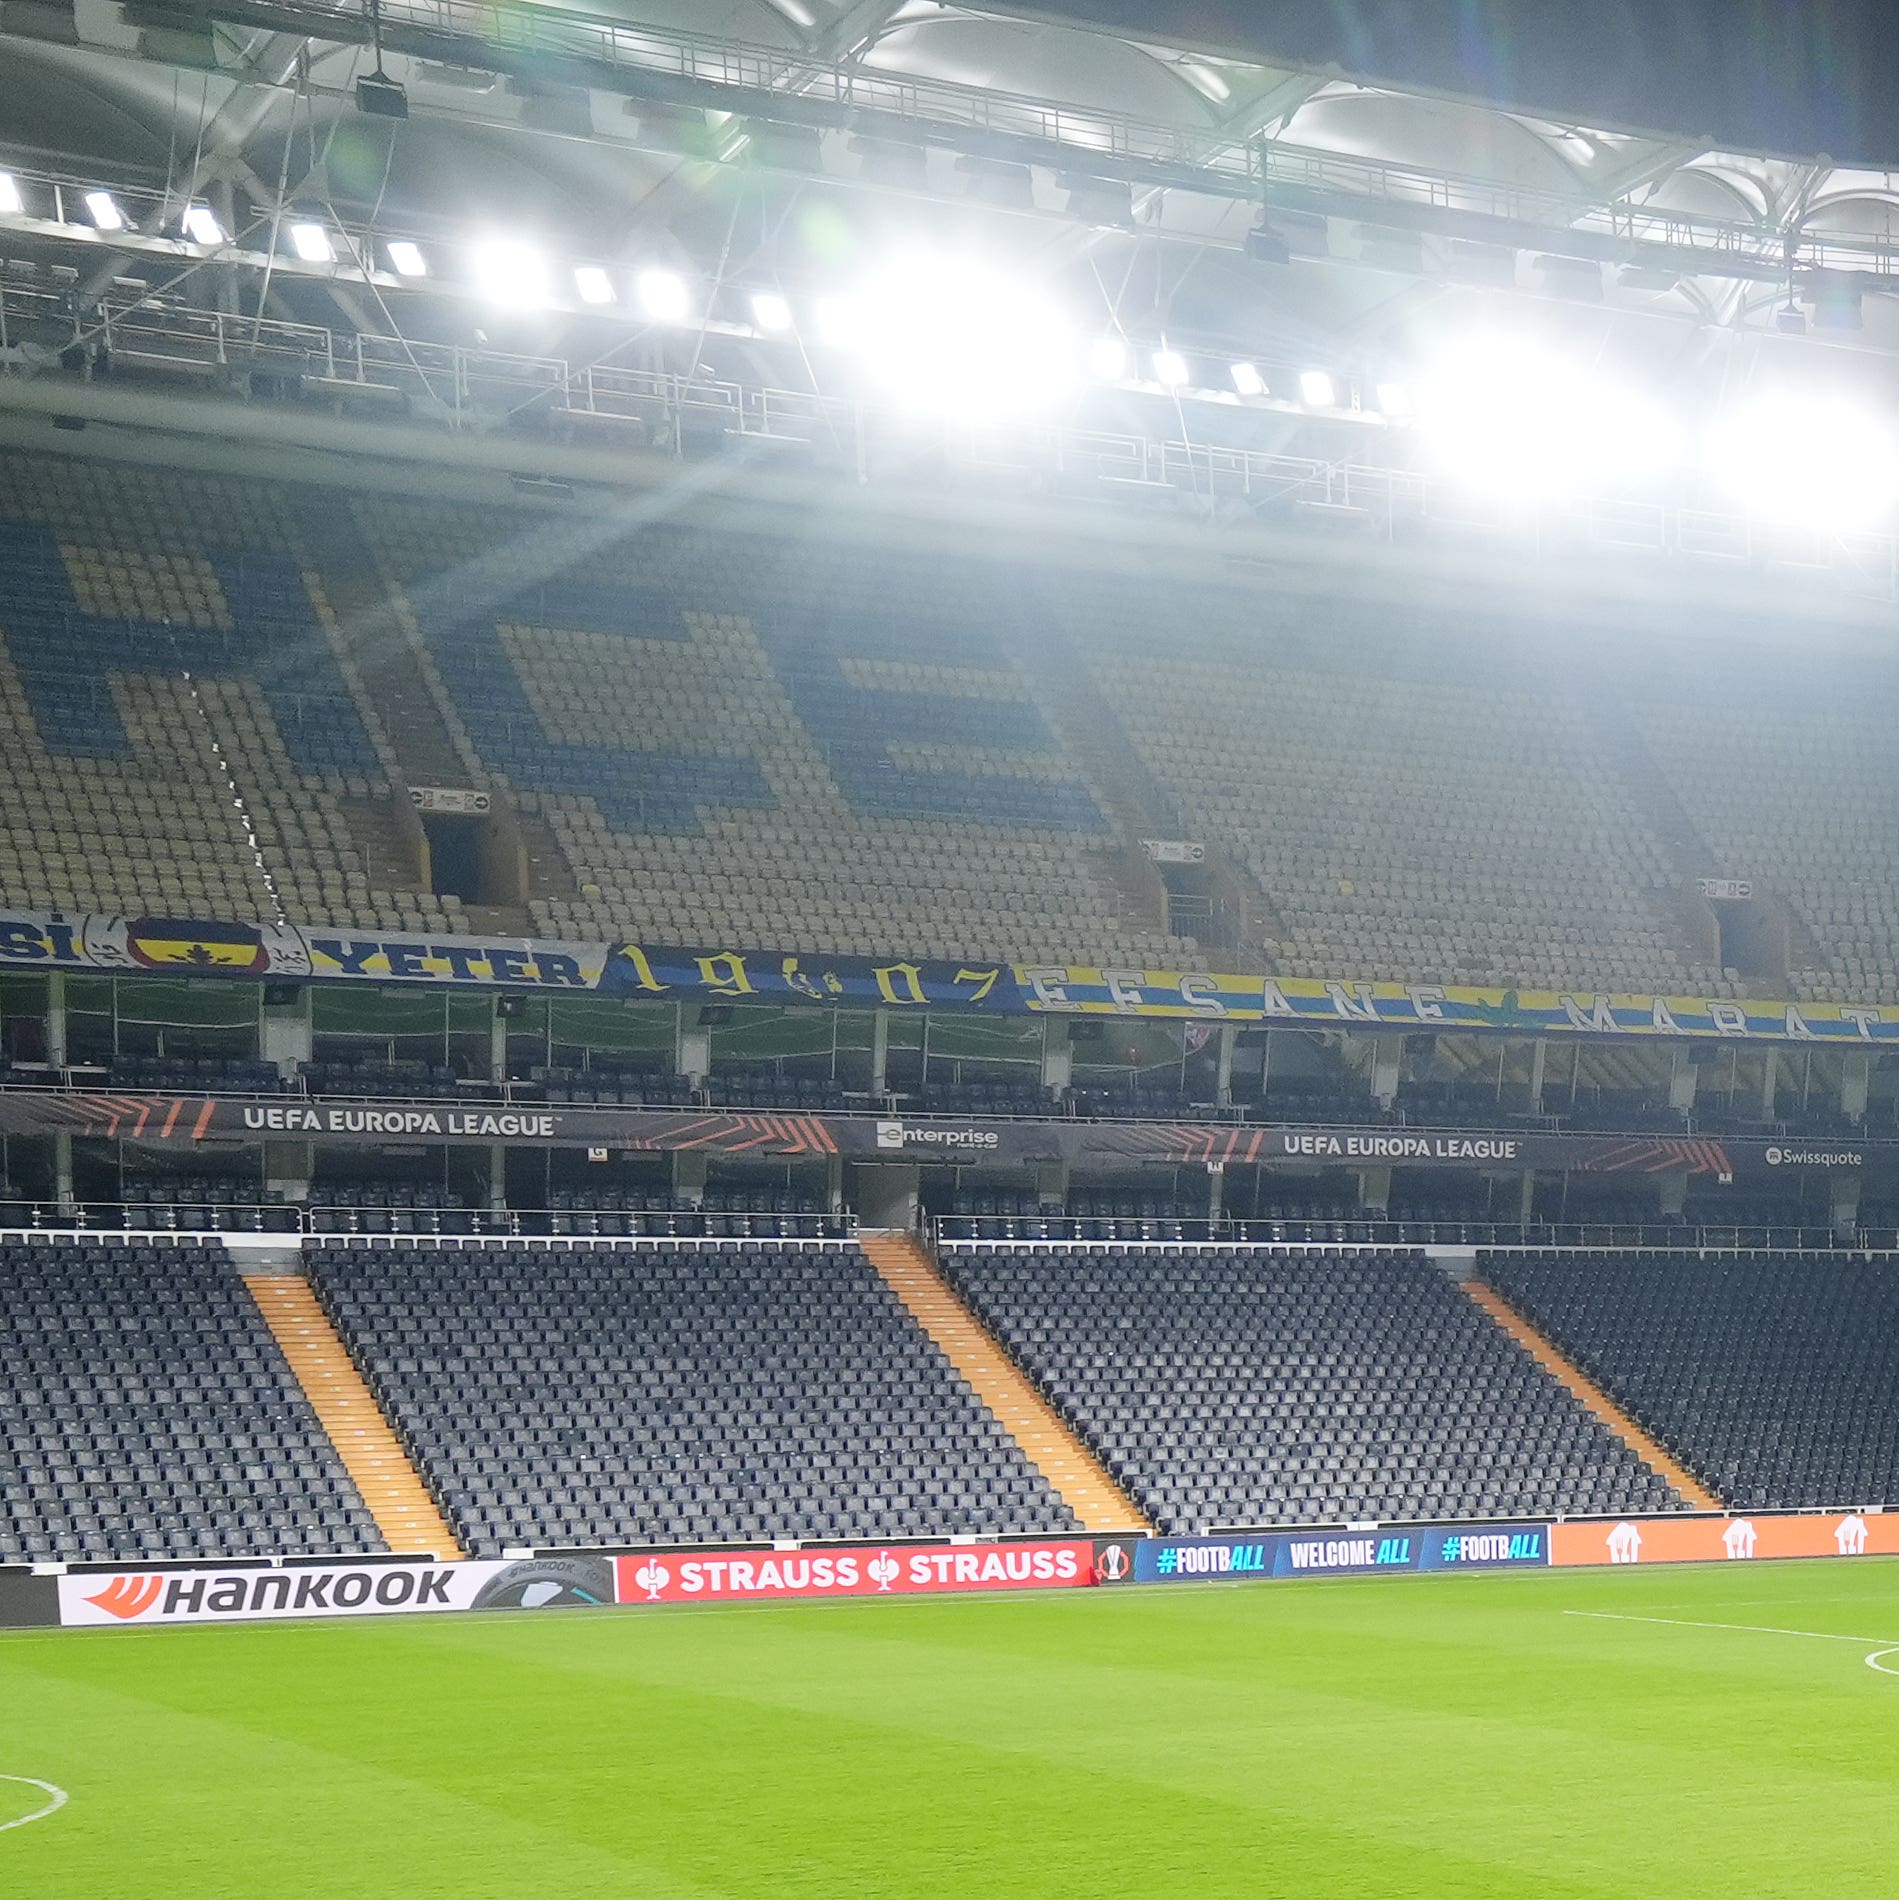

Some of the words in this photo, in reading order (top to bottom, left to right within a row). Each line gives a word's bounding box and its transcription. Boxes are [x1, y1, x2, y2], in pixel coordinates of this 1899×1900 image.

[310, 938, 587, 986] YETER
[244, 1108, 322, 1131] UEFA
[328, 1111, 441, 1135] EUROPA
[447, 1113, 554, 1137] LEAGUE
[885, 1124, 999, 1149] enterprise
[1283, 1135, 1344, 1157] UEFA
[1347, 1136, 1432, 1159] EUROPA
[1436, 1138, 1518, 1161] LEAGUE
[1783, 1146, 1863, 1167] Swissquote
[1154, 1541, 1265, 1577] #FOOTBALL
[1290, 1538, 1372, 1571] WELCOME
[1373, 1535, 1410, 1565] ALL
[1441, 1531, 1542, 1564] #FOOTBALL
[678, 1555, 860, 1598] STRAUSS
[908, 1545, 1079, 1584] STRAUSS
